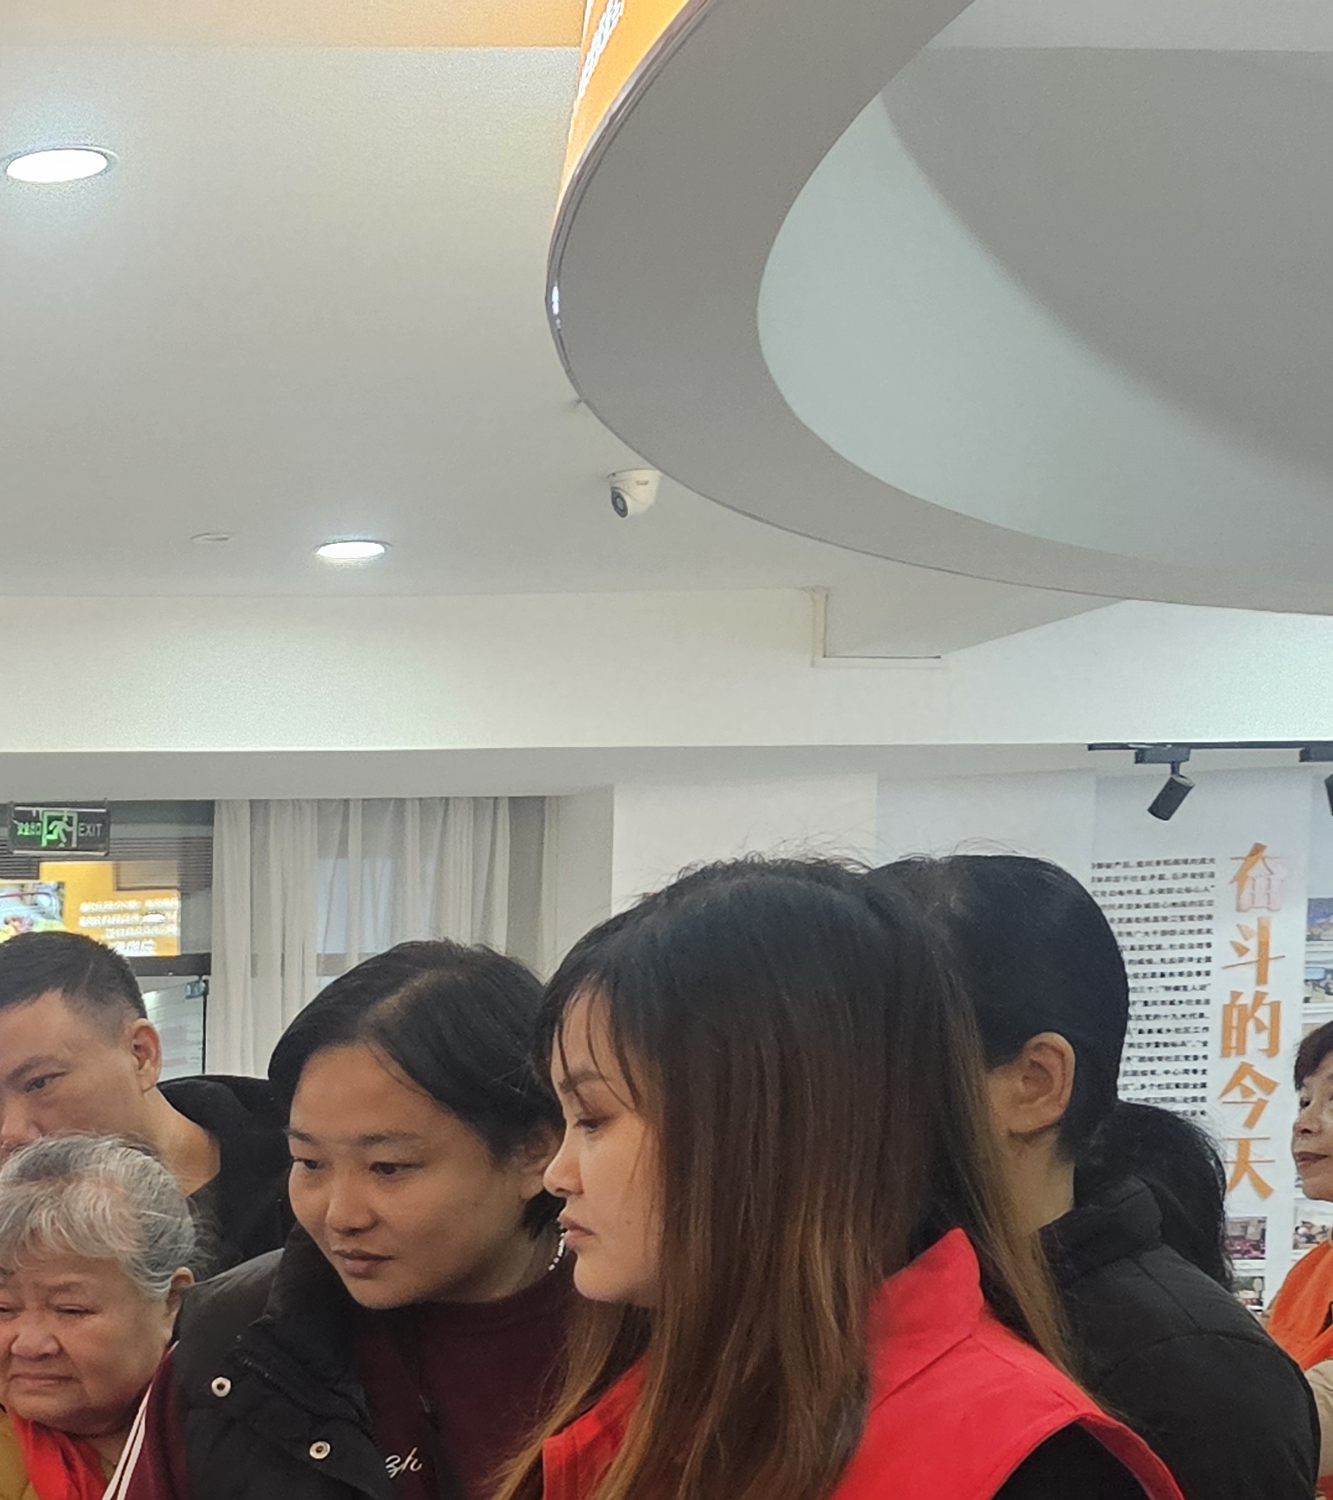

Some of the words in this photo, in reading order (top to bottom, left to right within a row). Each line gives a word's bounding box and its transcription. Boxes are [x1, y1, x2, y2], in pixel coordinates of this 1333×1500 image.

[78, 823, 103, 837] EXIT
[1218, 842, 1286, 1199] 奋斗的今天
